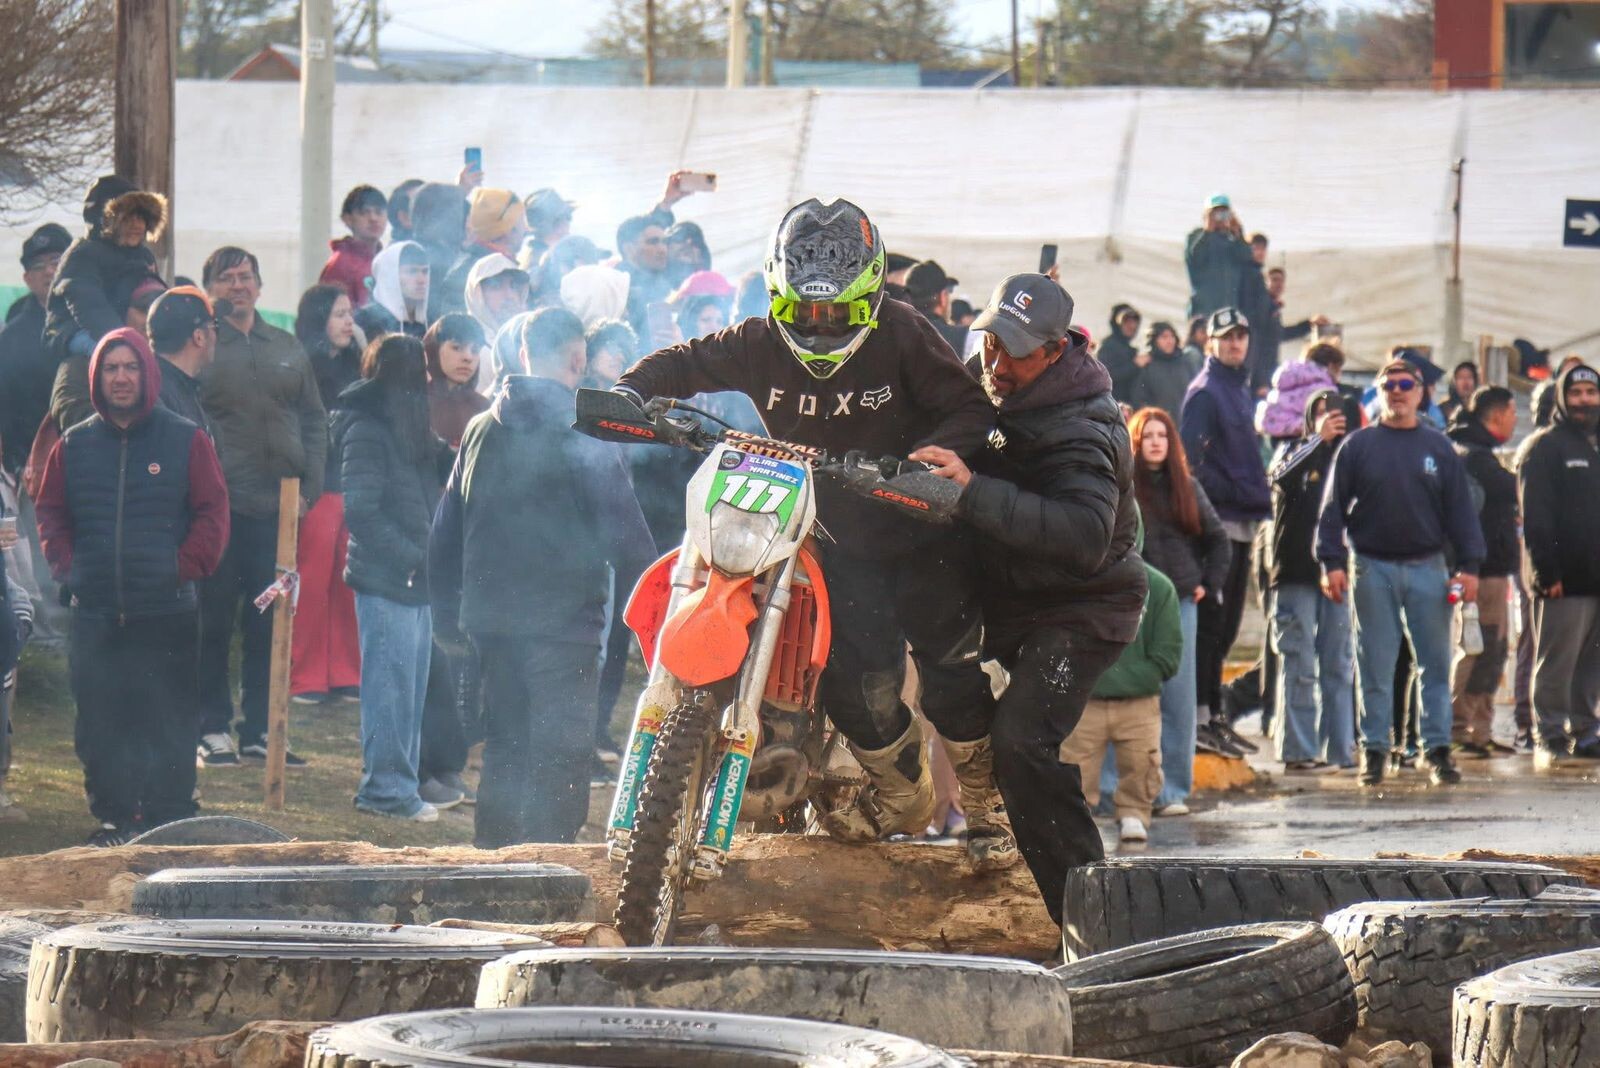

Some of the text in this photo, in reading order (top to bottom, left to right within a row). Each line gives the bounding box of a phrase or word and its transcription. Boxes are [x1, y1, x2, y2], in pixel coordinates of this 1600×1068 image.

[805, 283, 832, 293] BELL
[766, 387, 854, 416] FOX
[597, 419, 656, 440] ACERBIS
[725, 428, 818, 456] REAL
[748, 456, 779, 468] ELIAS
[748, 465, 800, 485] MARTINEZ
[719, 474, 792, 514] 111
[614, 754, 641, 823] MOTOREX
[717, 757, 744, 827] MOTOREX
